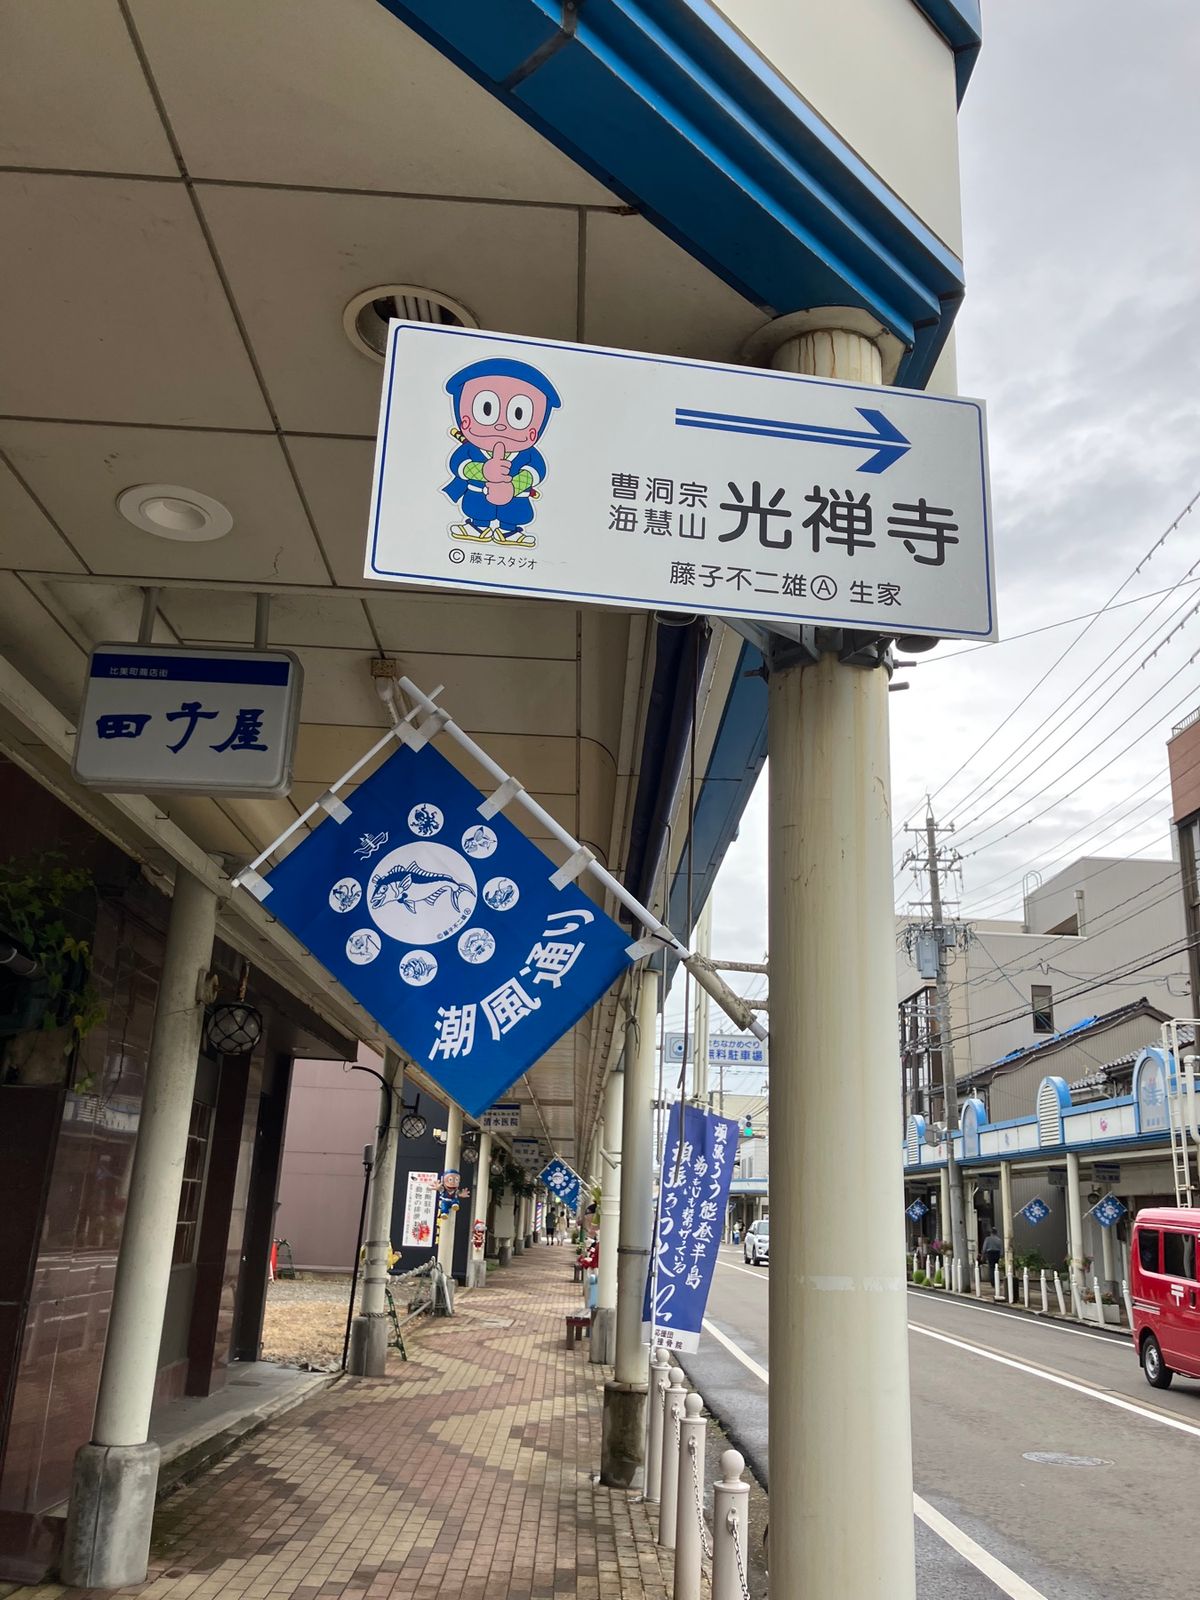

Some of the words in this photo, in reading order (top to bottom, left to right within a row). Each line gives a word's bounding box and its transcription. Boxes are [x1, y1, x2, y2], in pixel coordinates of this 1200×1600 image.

[611, 471, 709, 509] 曹洞宗
[607, 504, 707, 541] 海慧山
[718, 479, 960, 567] 光禅寺
[850, 578, 902, 607] 生家
[428, 908, 595, 1061] 潮風通り
[709, 1039, 760, 1049] ちなかめぐり
